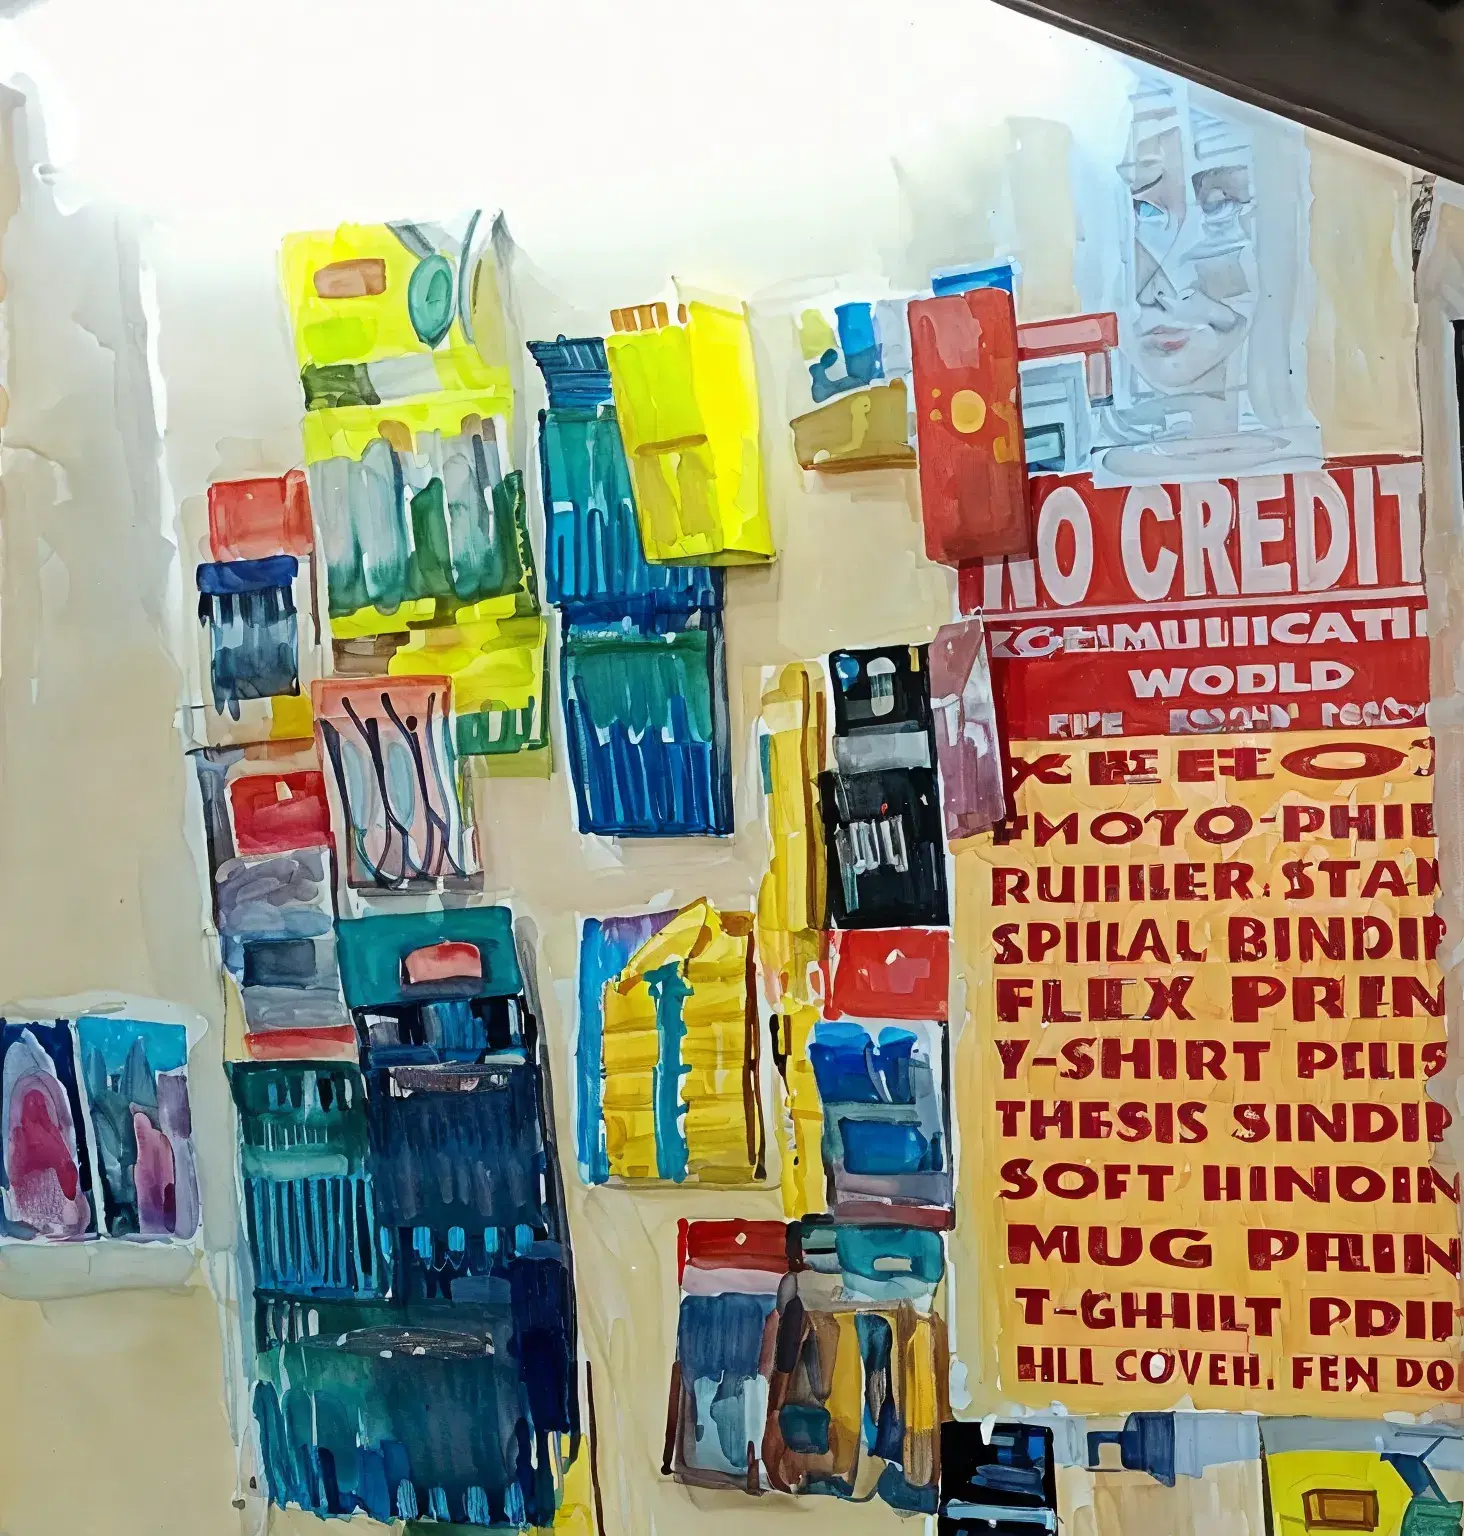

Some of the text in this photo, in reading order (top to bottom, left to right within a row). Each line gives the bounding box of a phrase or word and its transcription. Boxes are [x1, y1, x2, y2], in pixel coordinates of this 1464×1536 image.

[1120, 464, 1424, 602] CREDIT
[995, 1099, 1209, 1143] THESIS
[997, 1157, 1175, 1201] SOFT
[1007, 1223, 1213, 1269] MUG
